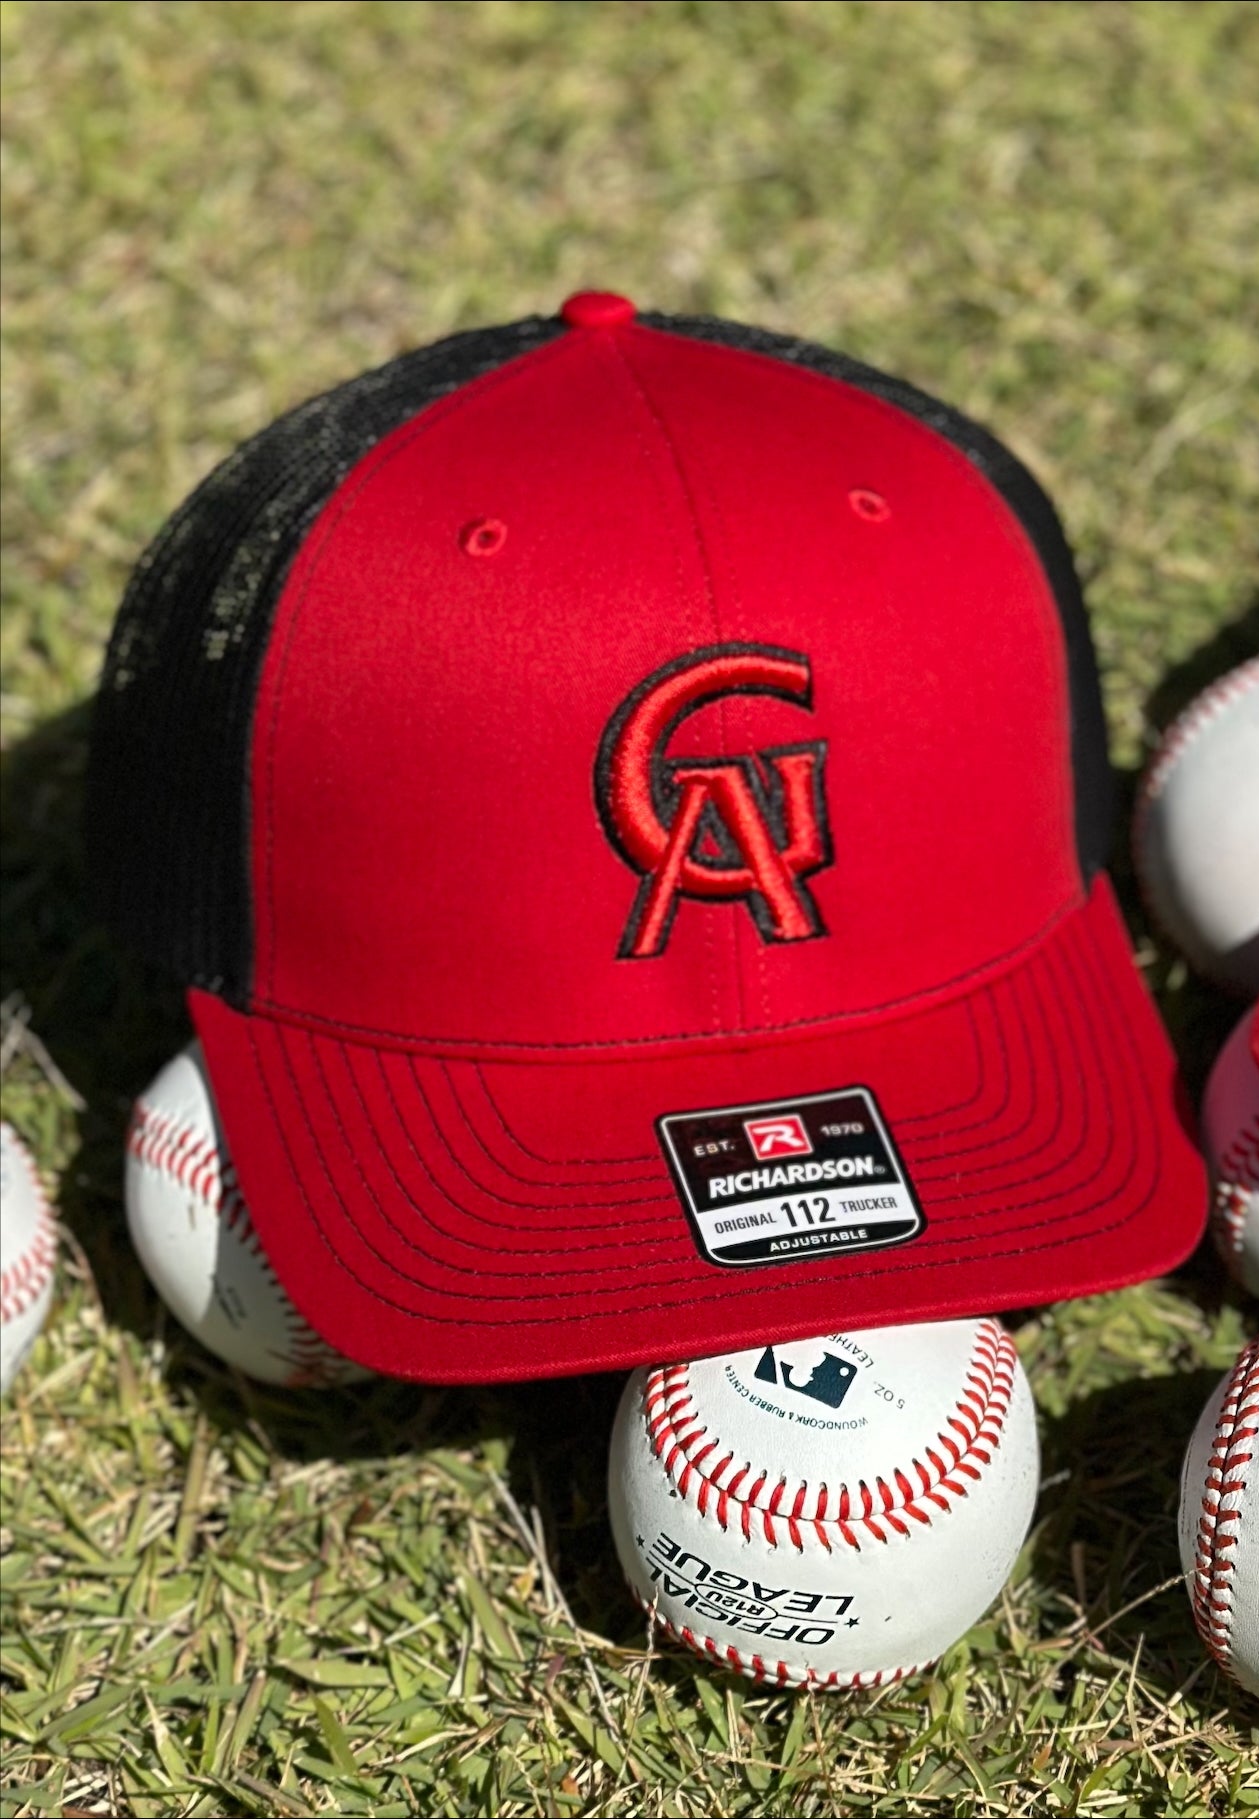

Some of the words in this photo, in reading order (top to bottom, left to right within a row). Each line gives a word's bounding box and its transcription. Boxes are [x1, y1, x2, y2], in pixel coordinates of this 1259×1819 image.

[694, 1140, 735, 1157] EST.
[820, 1122, 864, 1137] 1970
[714, 1212, 778, 1235] ORIGINAL
[780, 1197, 836, 1228] 112
[838, 1196, 898, 1217] TRUCKER
[769, 1227, 869, 1253] ADJUSTABLE
[724, 1364, 750, 1398] CENTER
[749, 1395, 786, 1418] RUBBER
[896, 1398, 906, 1410] 5
[652, 1532, 855, 1616] LEAGUE
[645, 1557, 835, 1645] OFFICIAL
[705, 1590, 766, 1616] R12U
